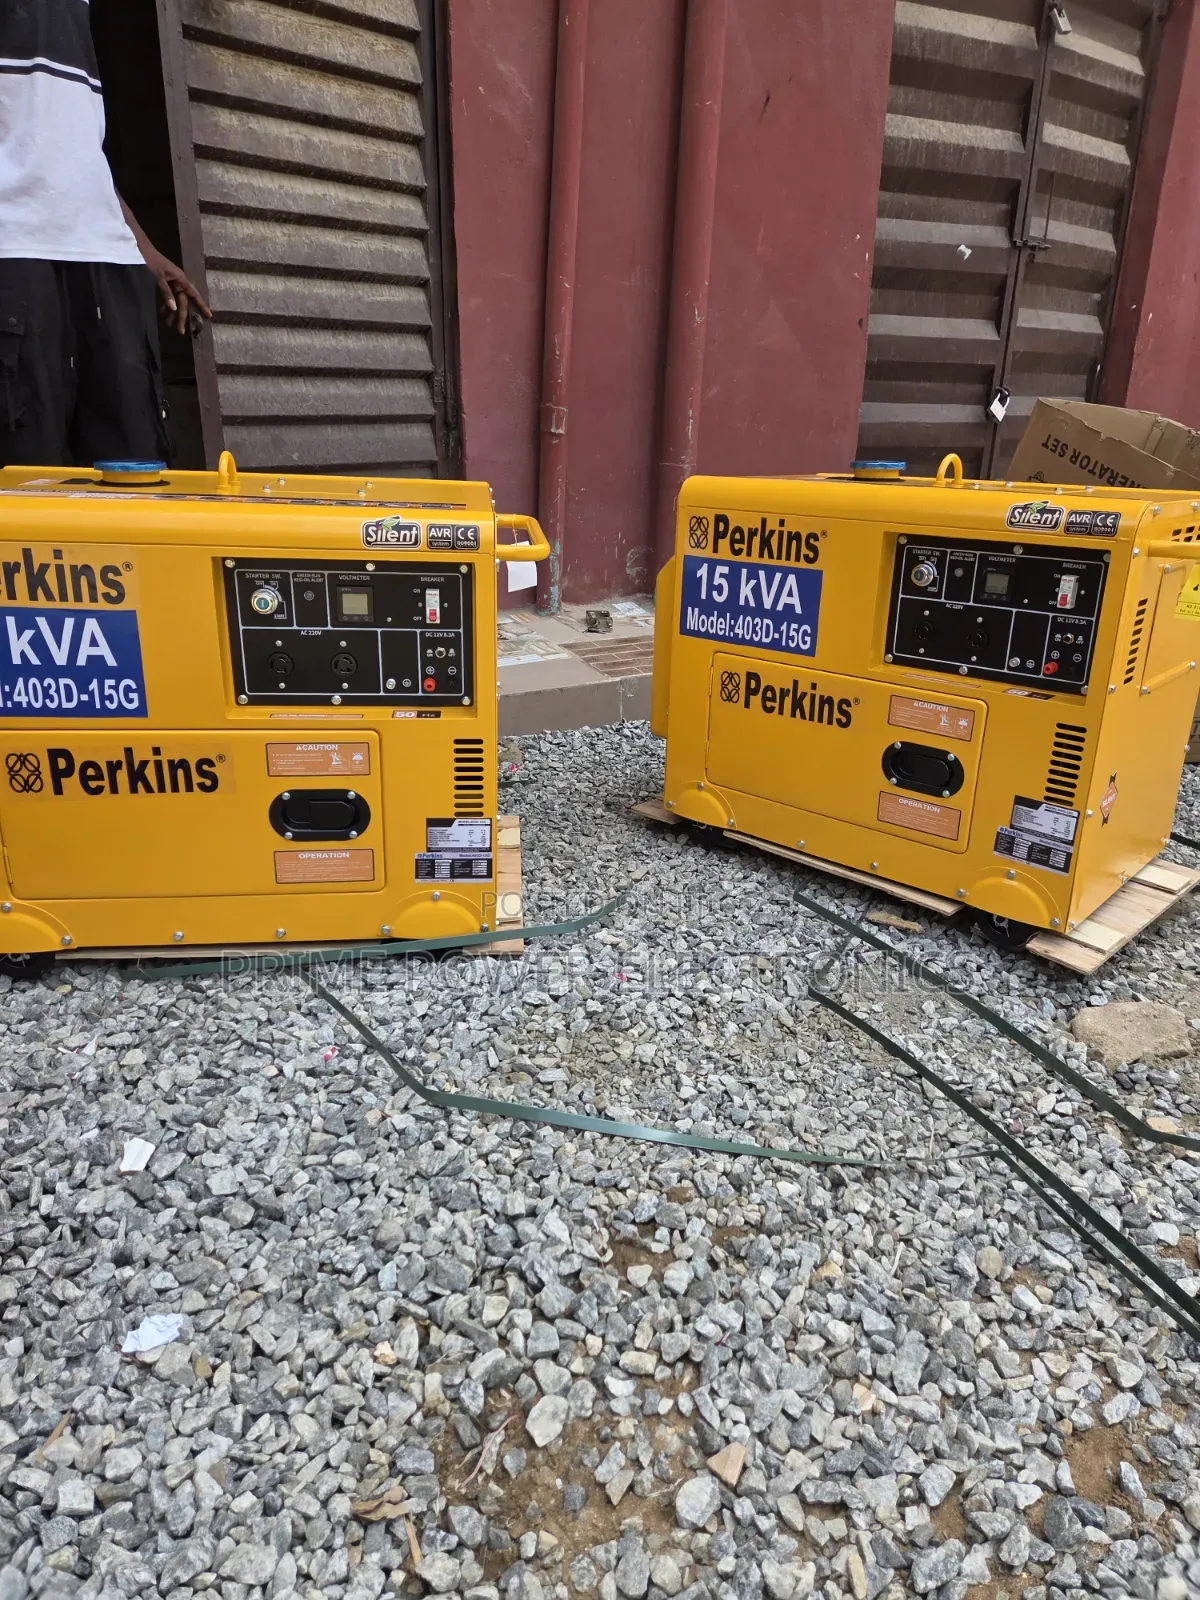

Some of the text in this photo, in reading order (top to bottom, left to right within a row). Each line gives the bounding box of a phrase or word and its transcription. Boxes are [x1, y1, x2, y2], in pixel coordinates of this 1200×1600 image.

[1041, 434, 1069, 458] SET
[1011, 506, 1060, 525] Silent
[1068, 514, 1091, 524] AVR
[367, 524, 418, 542] Silent
[429, 528, 451, 538] AVR
[696, 562, 802, 615] 15 kVA
[686, 606, 811, 650] Model:403D-15G
[5, 615, 118, 667] kVA
[918, 701, 949, 712] CAUTION
[898, 798, 940, 813] OPERATION
